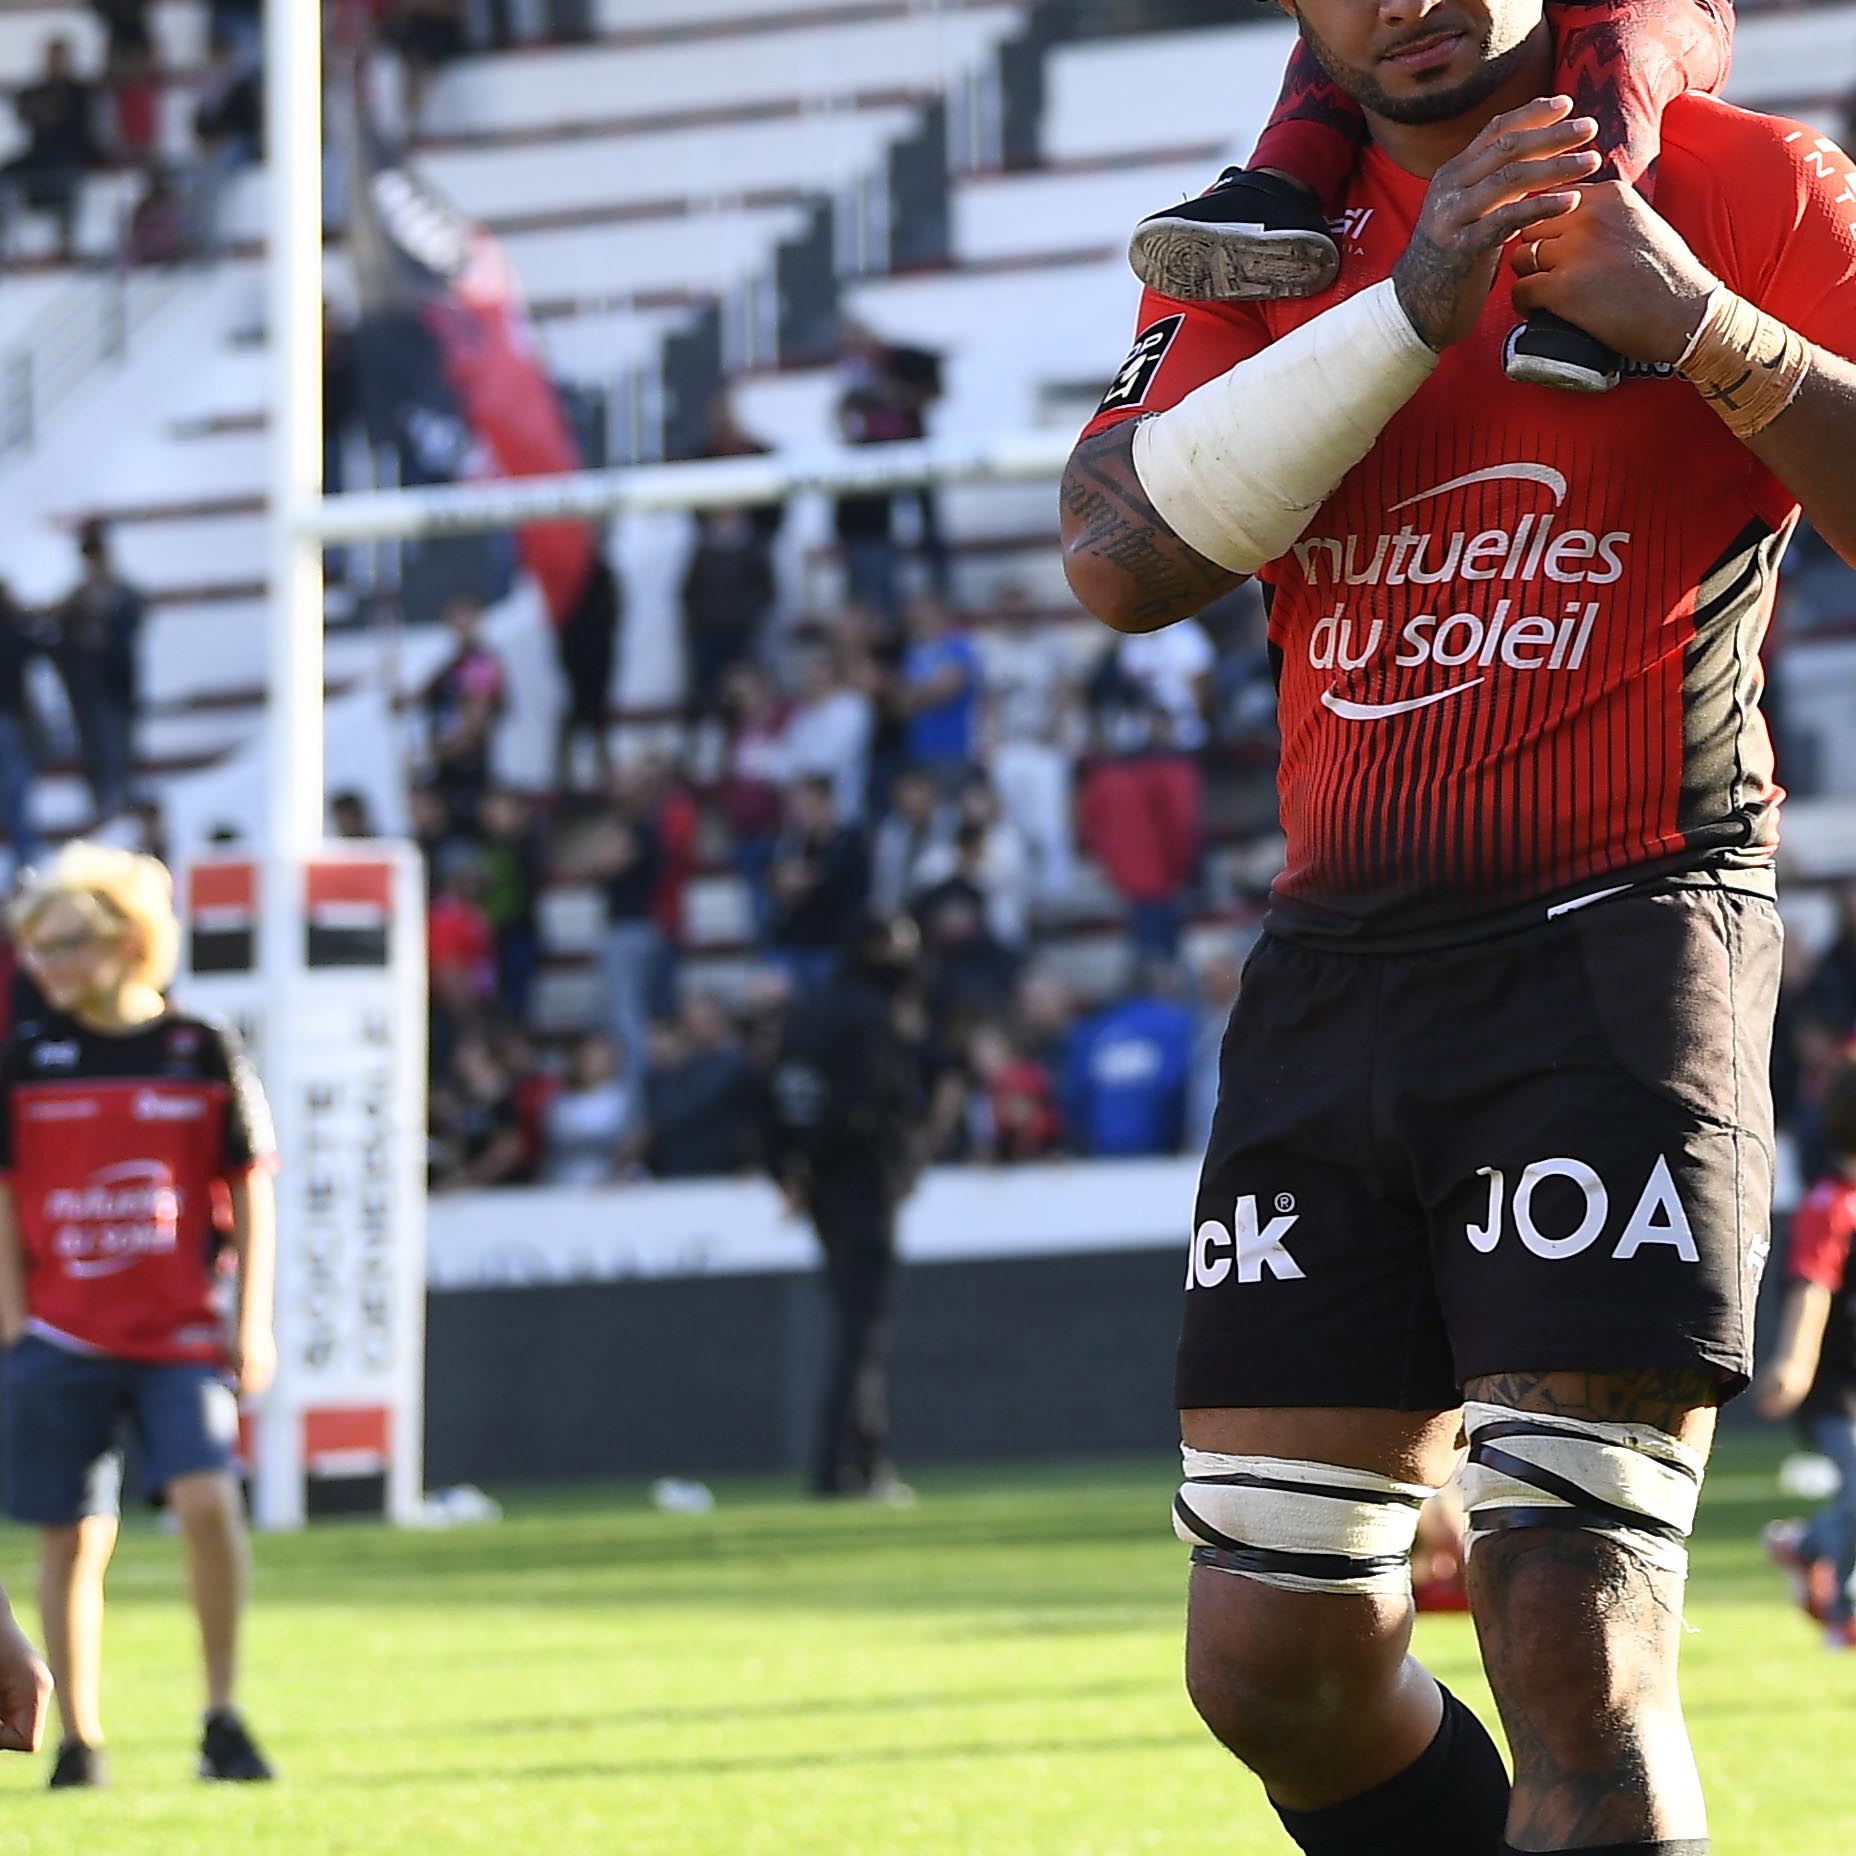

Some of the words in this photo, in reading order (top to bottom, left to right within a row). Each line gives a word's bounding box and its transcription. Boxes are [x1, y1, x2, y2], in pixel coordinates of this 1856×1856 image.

[1292, 514, 1631, 586] mutuelles
[1309, 602, 1384, 671] du
[1396, 599, 1600, 670] soleil
[1466, 1152, 1700, 1263] JOA
